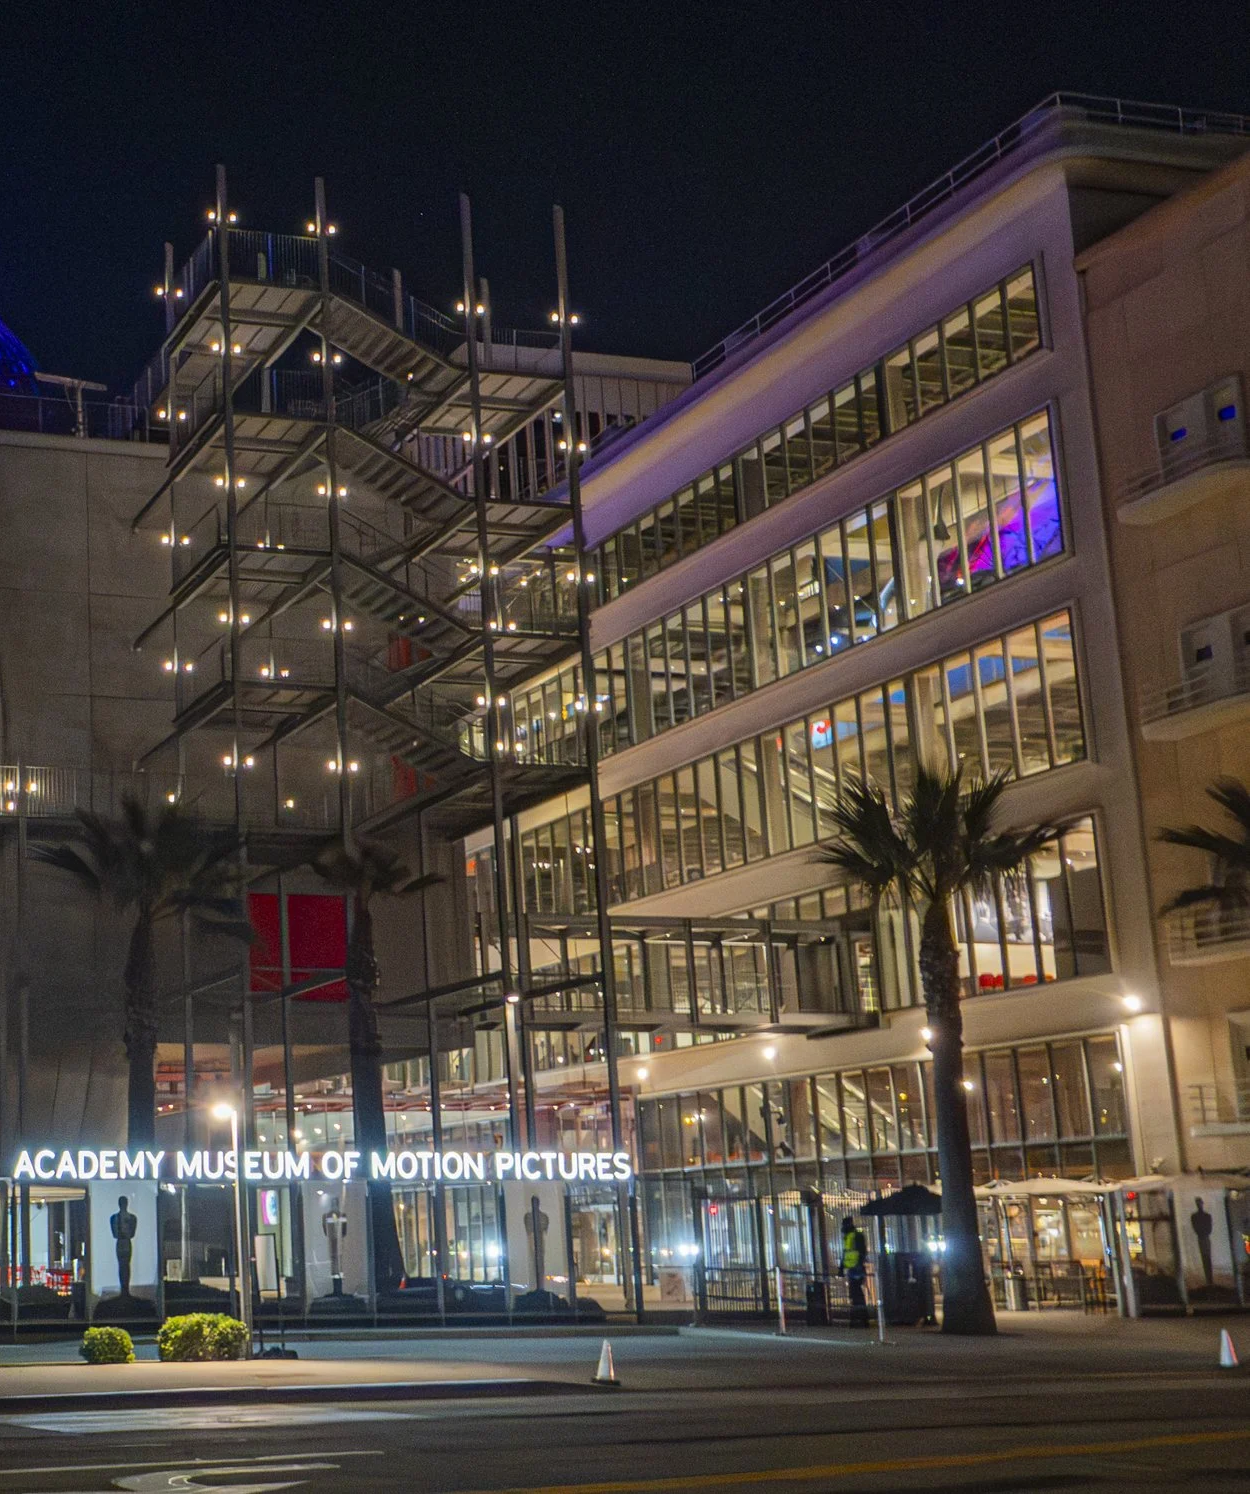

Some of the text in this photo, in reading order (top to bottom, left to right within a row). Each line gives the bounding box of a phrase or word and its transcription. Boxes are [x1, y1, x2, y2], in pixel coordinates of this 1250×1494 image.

[12, 1149, 633, 1181] ACADEMY MUSEUM OF MOTION PICTURES
